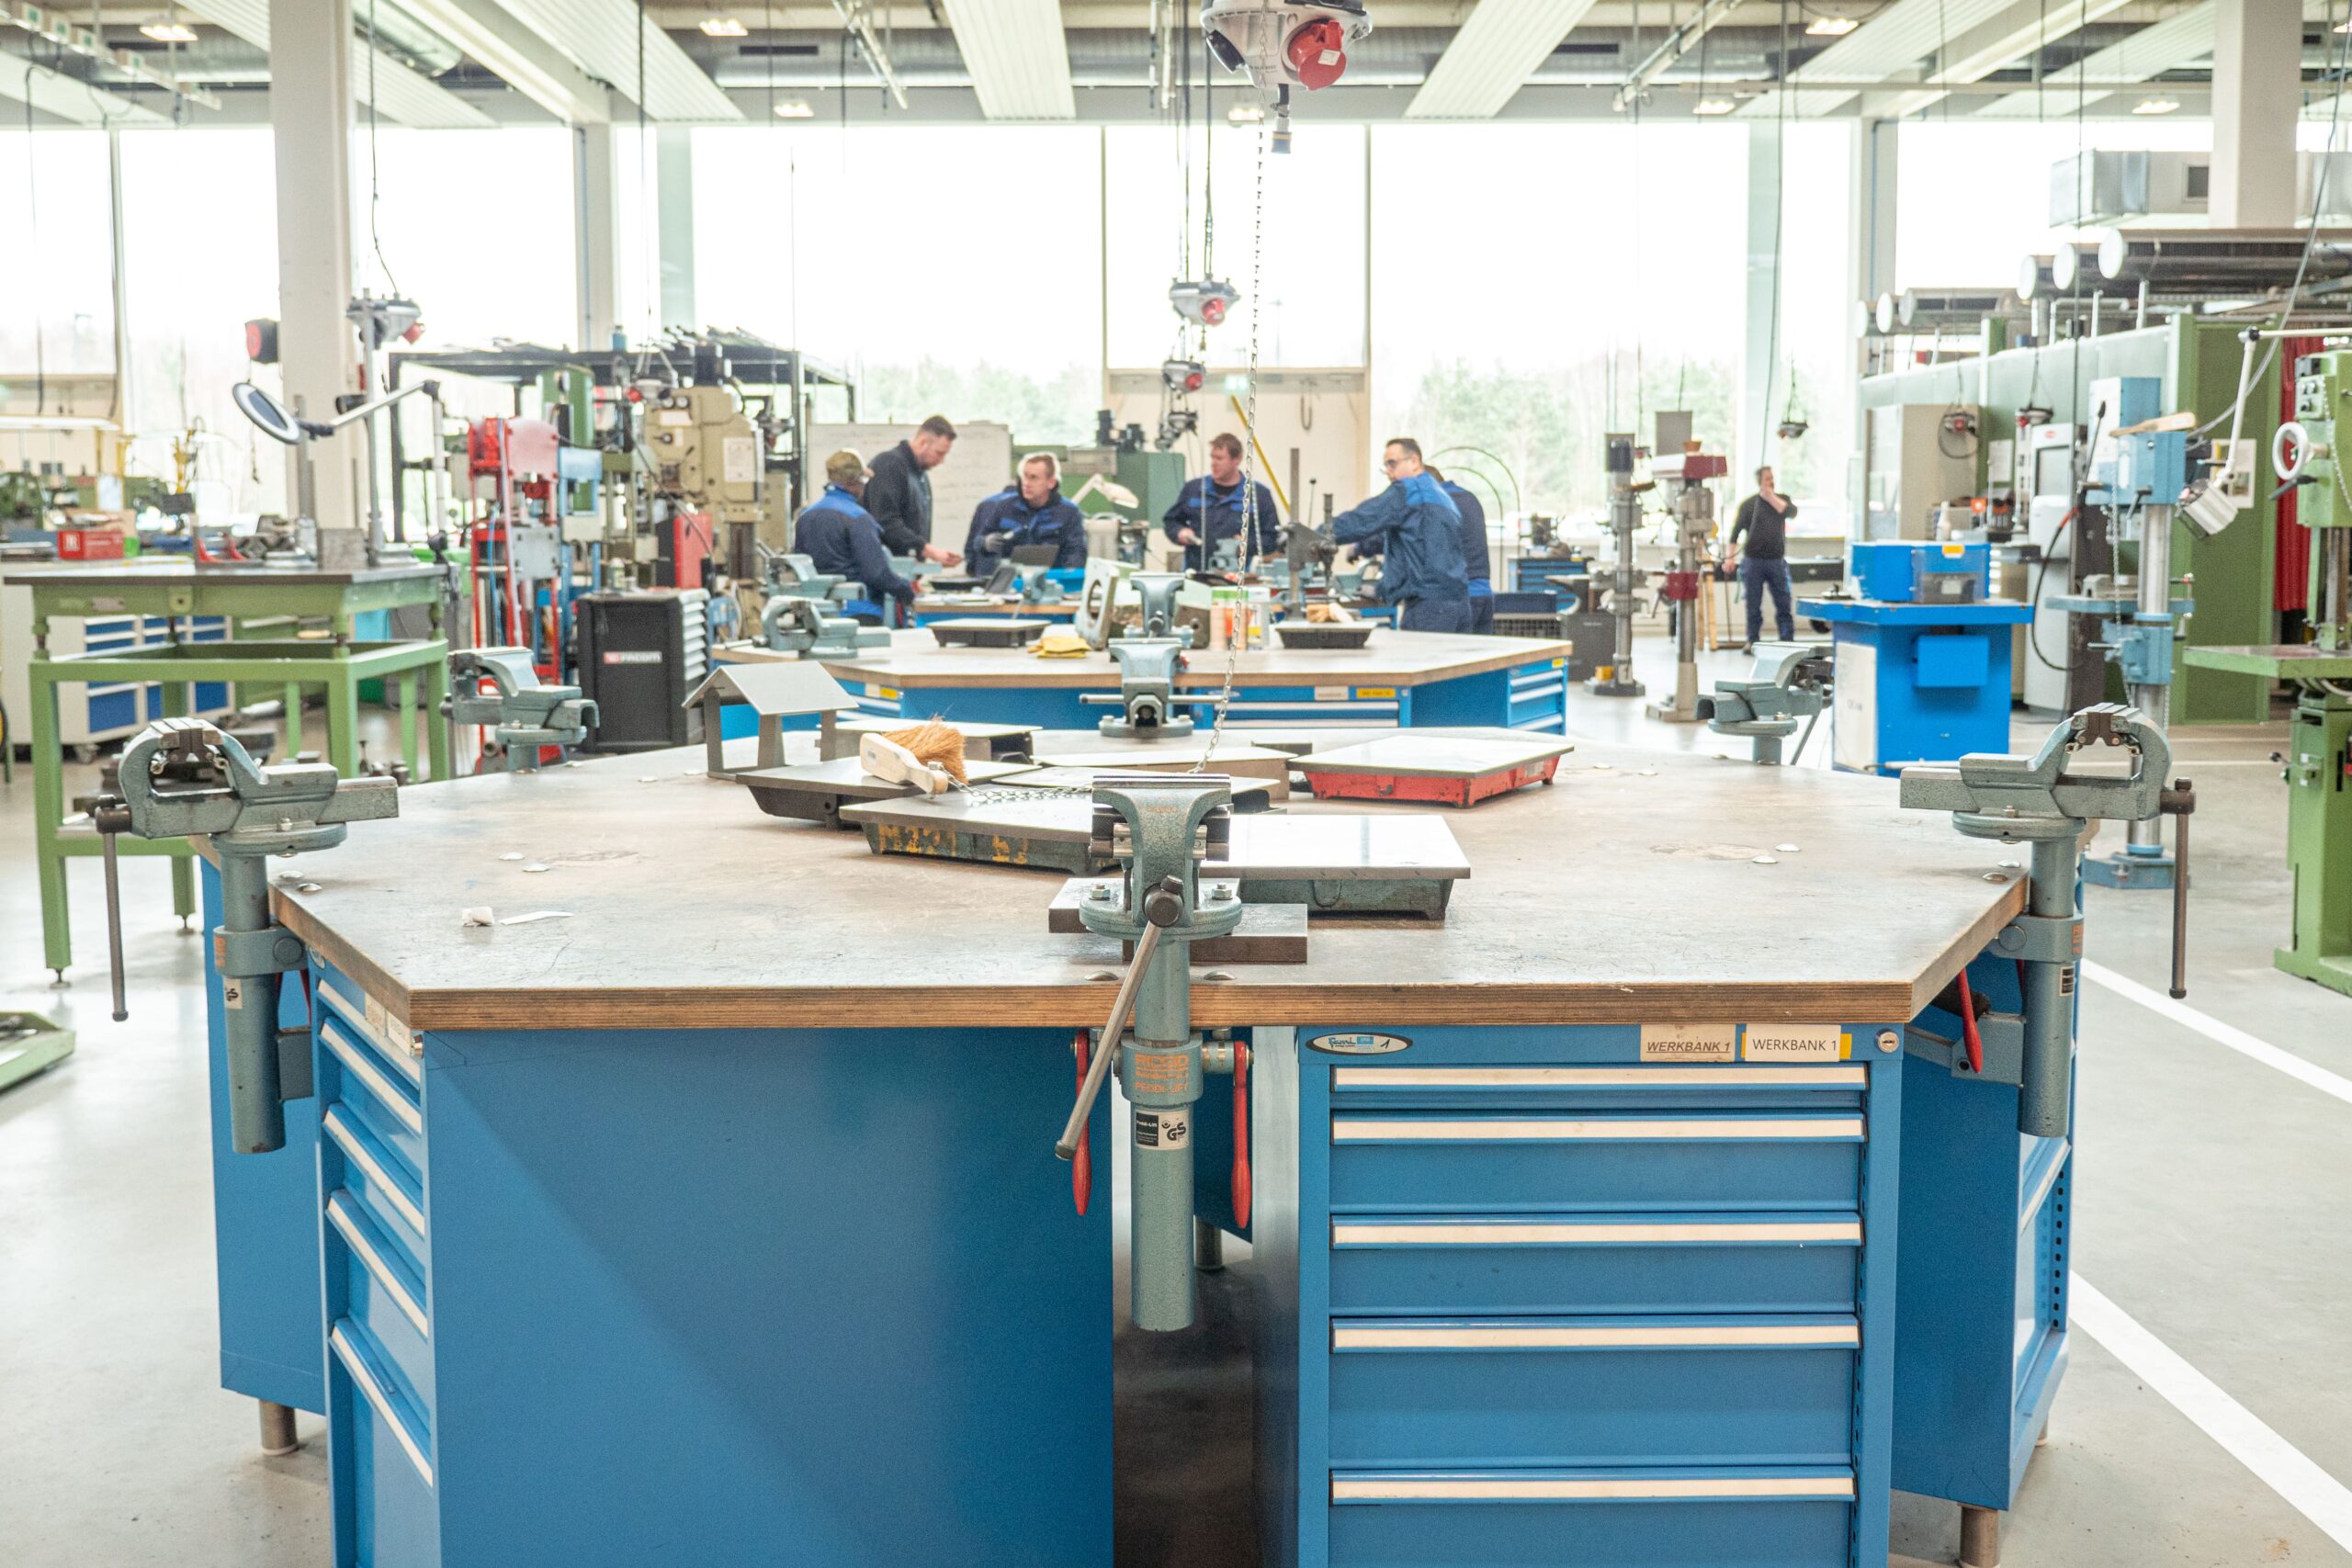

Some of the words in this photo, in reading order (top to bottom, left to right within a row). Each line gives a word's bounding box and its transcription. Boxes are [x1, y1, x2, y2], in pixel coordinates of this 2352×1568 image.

[1647, 1042, 1720, 1053] WERKBANK
[1724, 1042, 1731, 1052] 1
[1752, 1039, 1826, 1051] WERKBANK
[1831, 1040, 1837, 1051] 1
[1166, 1122, 1187, 1141] GS
